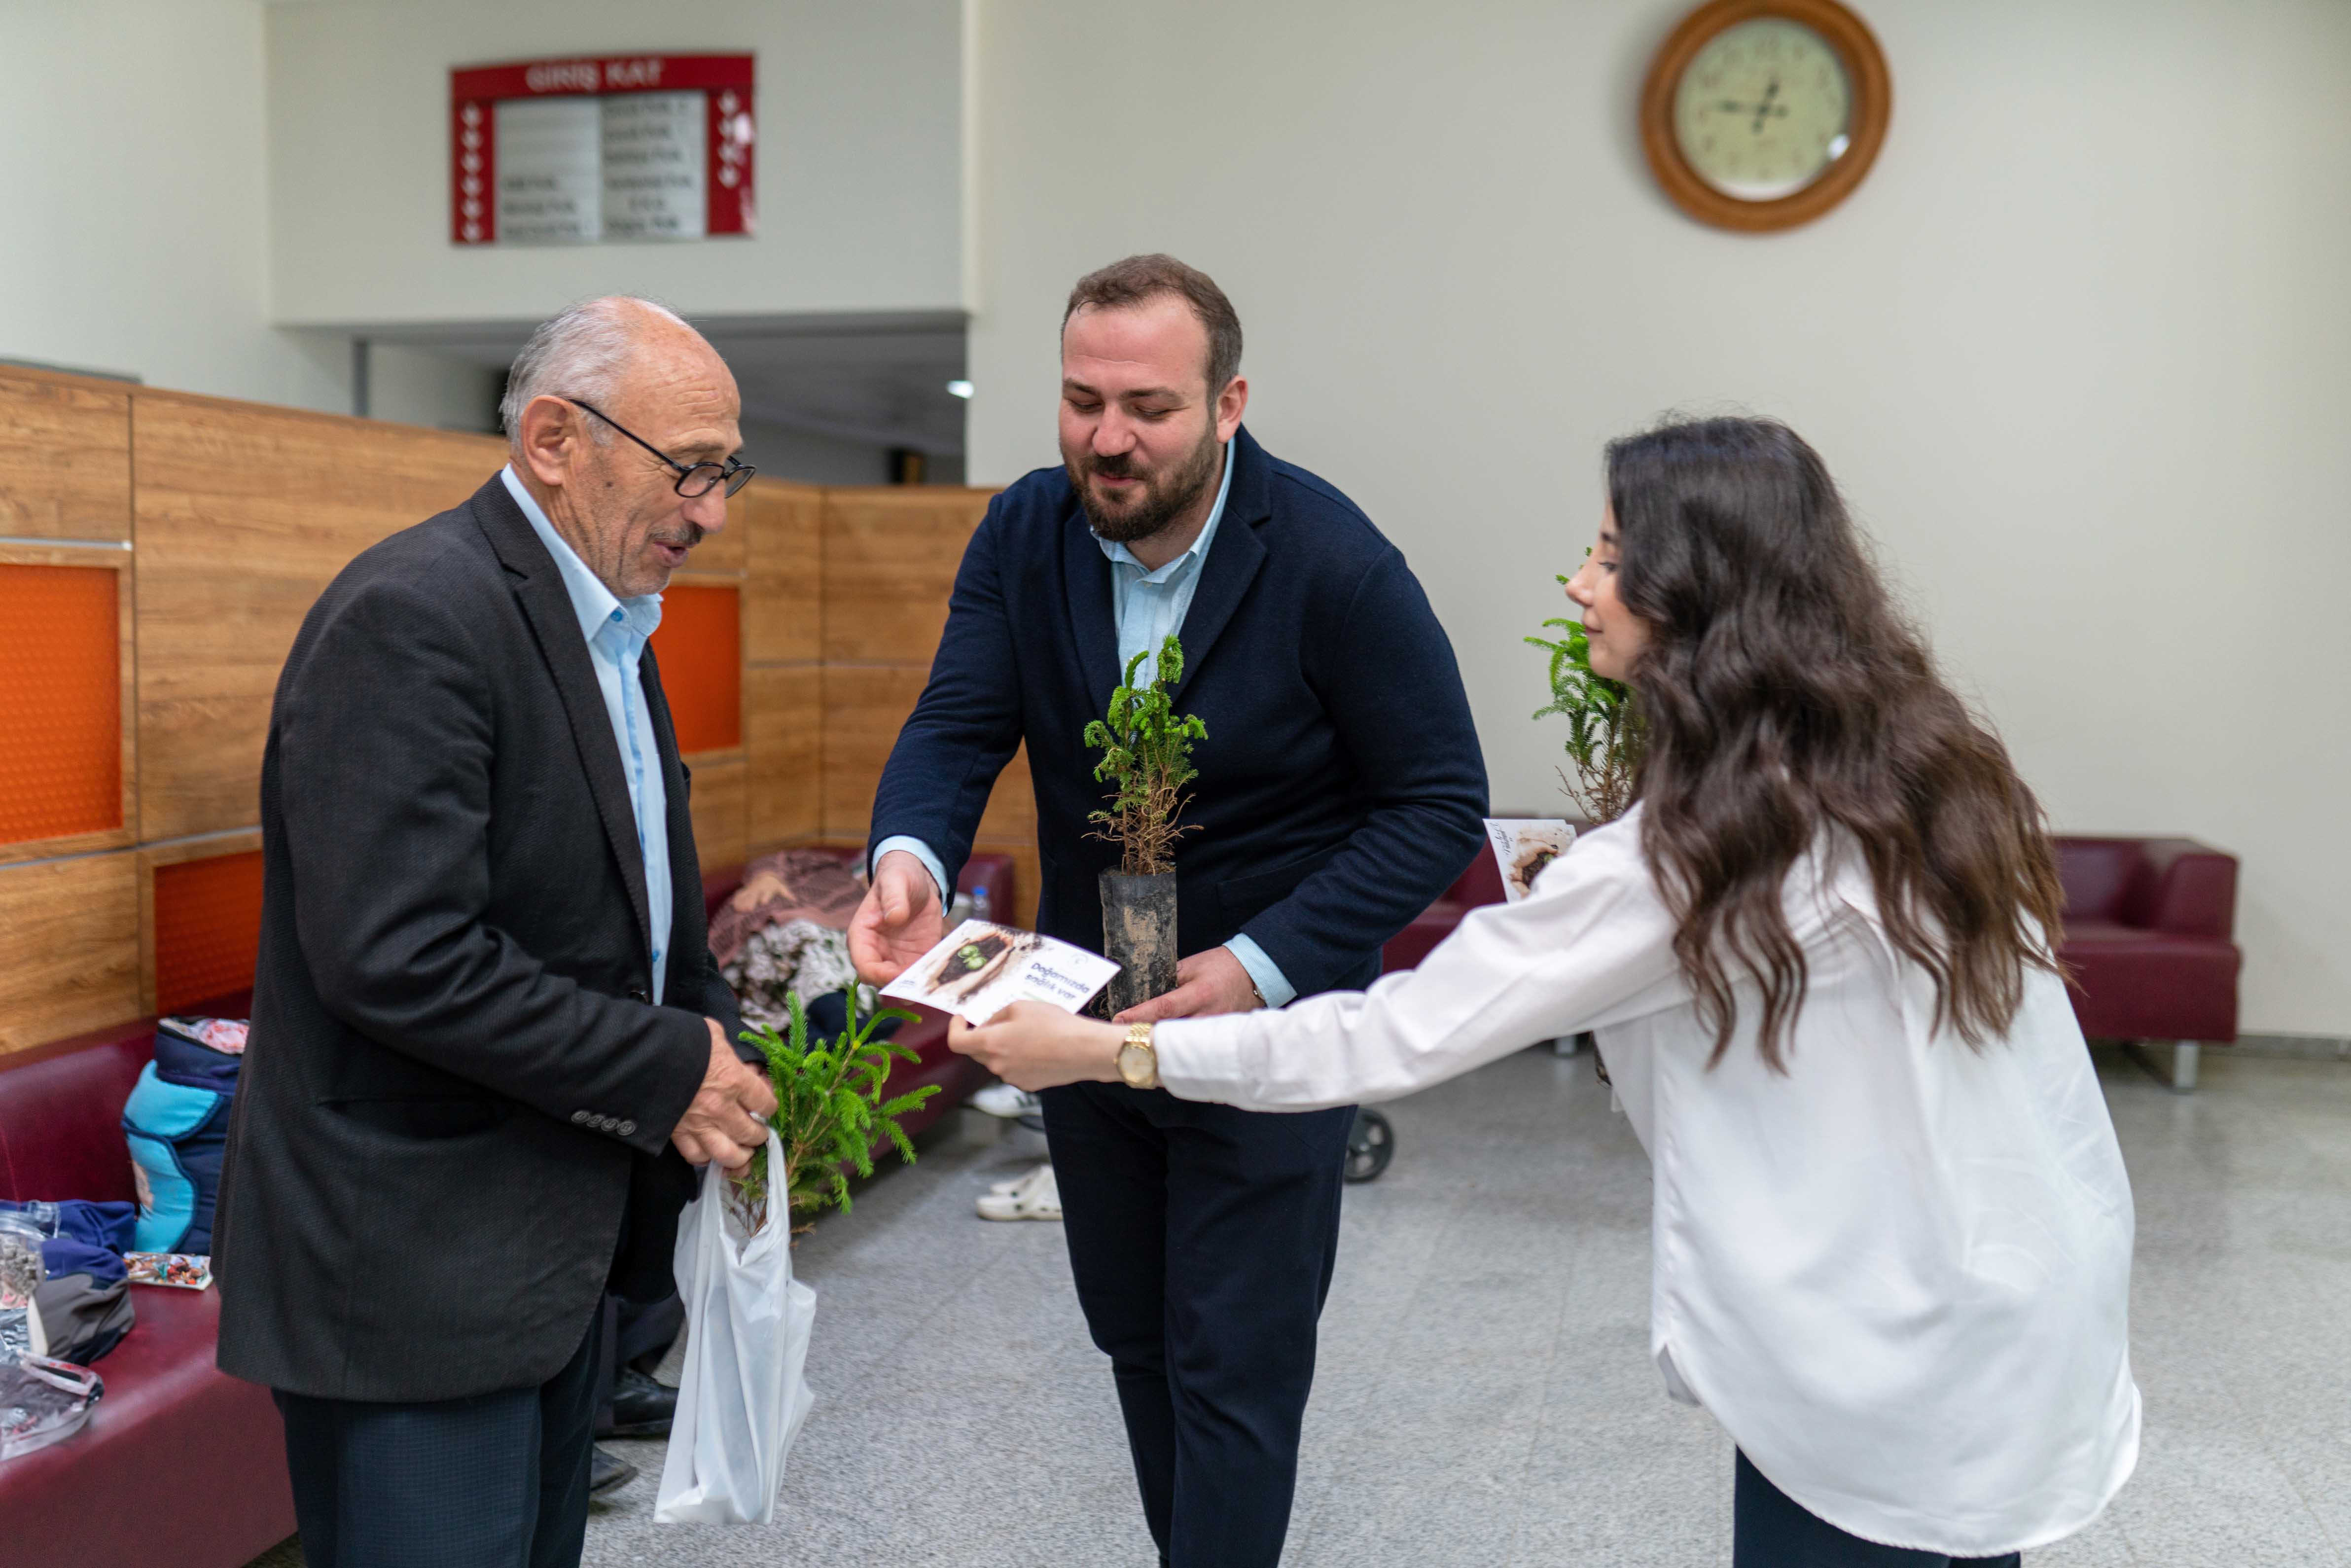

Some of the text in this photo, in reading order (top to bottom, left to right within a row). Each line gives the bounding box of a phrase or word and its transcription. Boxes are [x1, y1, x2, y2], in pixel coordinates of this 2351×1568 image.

[606, 59, 662, 87] KAT
[1032, 962, 1090, 993] Doğamızda
[1058, 988, 1076, 998] var
